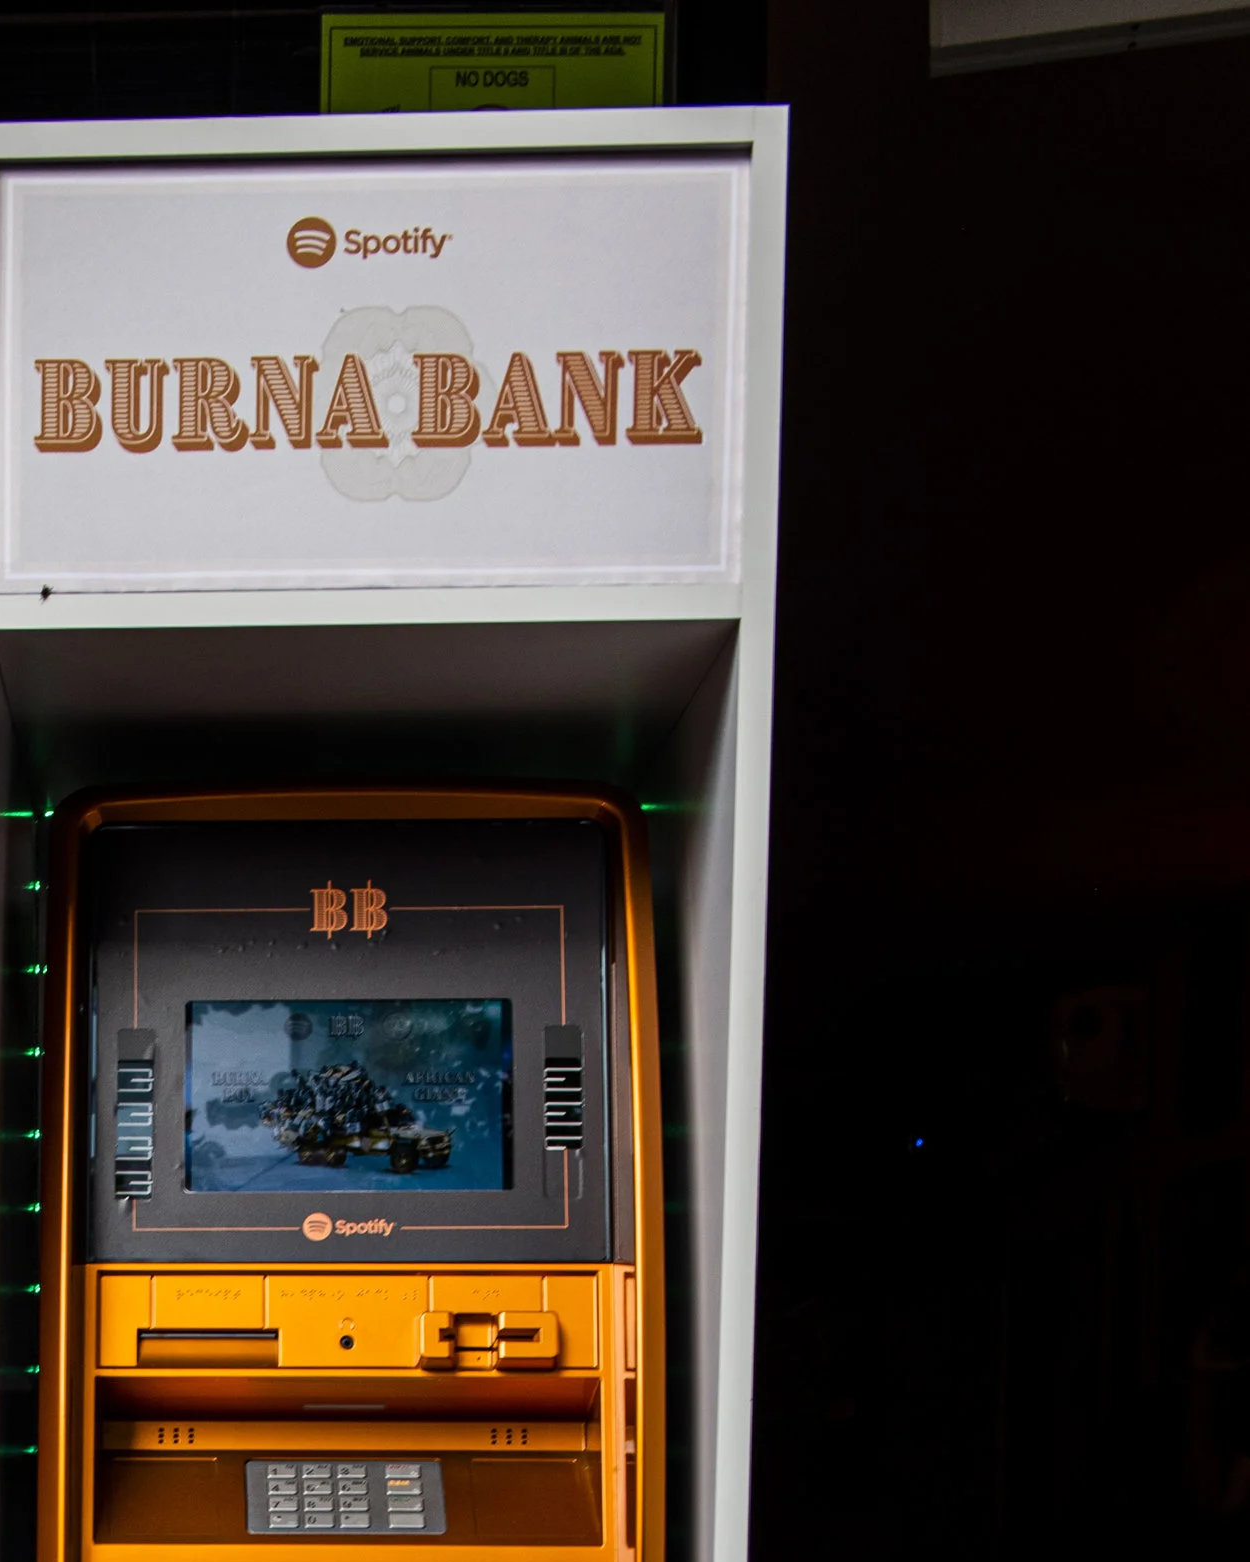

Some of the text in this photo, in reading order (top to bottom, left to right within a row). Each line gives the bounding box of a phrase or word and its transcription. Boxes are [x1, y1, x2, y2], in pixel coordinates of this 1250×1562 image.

[455, 70, 529, 88] NO DOGS
[343, 227, 449, 259] Spotify
[34, 349, 703, 452] BURNA BANK
[334, 1217, 396, 1237] Spotify
